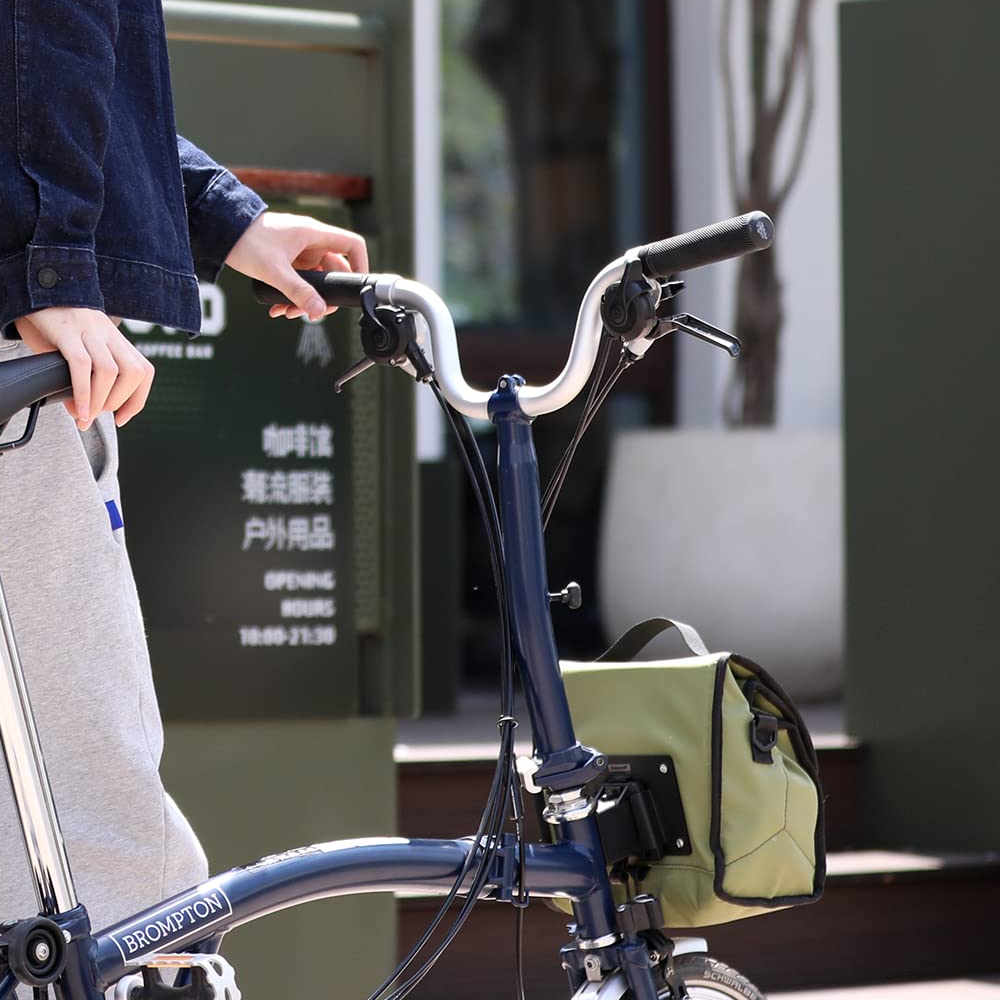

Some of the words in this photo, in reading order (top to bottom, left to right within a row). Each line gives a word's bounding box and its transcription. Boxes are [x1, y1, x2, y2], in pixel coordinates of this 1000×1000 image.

[262, 422, 333, 458] 咖啡馆
[242, 515, 335, 551] 户外用品
[264, 570, 335, 591] OPENING
[281, 598, 335, 618] HOURS
[122, 894, 223, 953] BROMPTON
